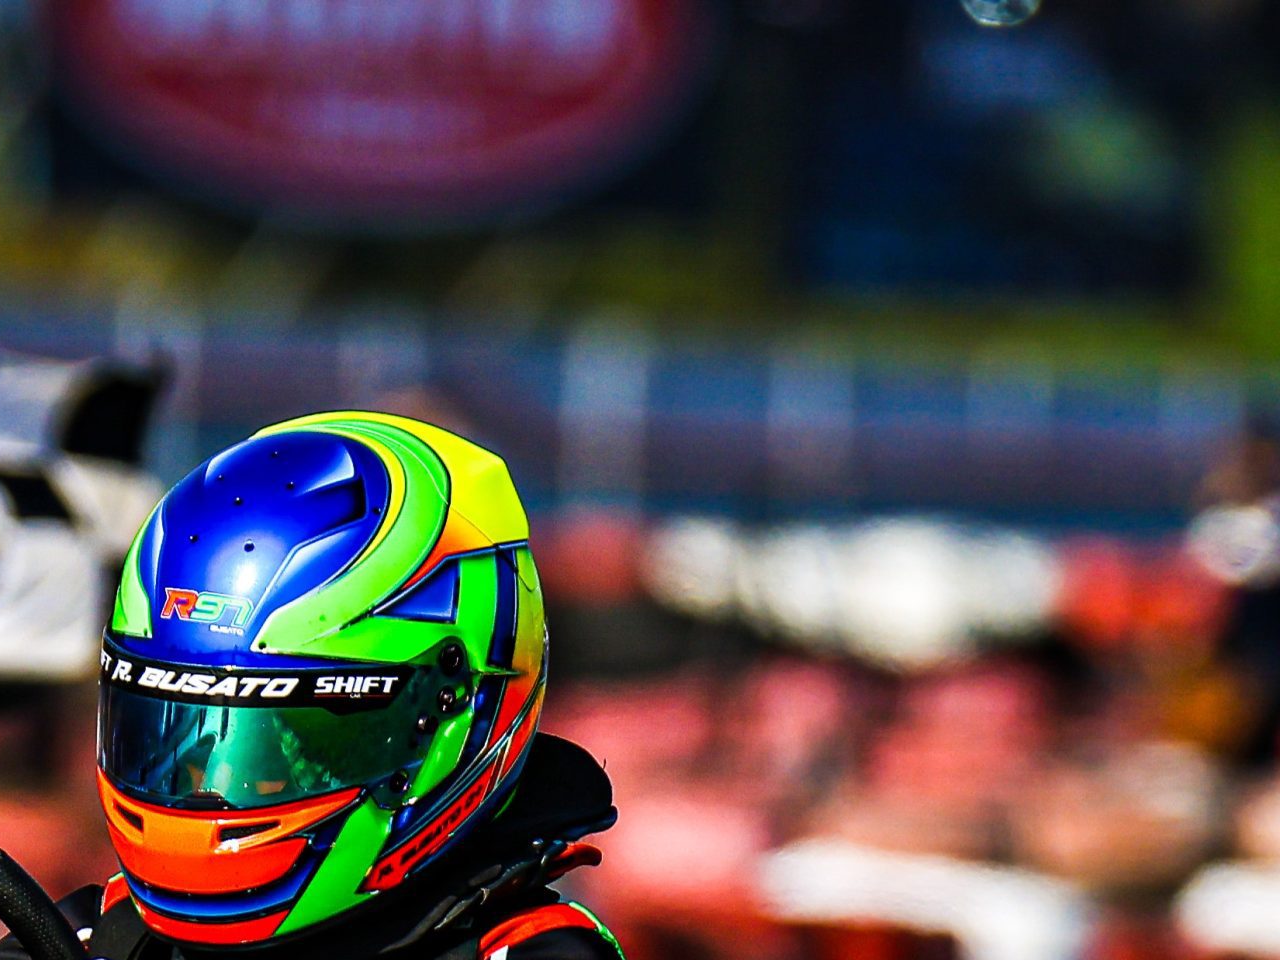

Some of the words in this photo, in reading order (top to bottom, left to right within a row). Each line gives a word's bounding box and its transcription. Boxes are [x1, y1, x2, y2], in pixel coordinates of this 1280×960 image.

[111, 659, 132, 682] R.
[138, 666, 299, 698] BUSATO
[314, 676, 399, 694] SHIFT
